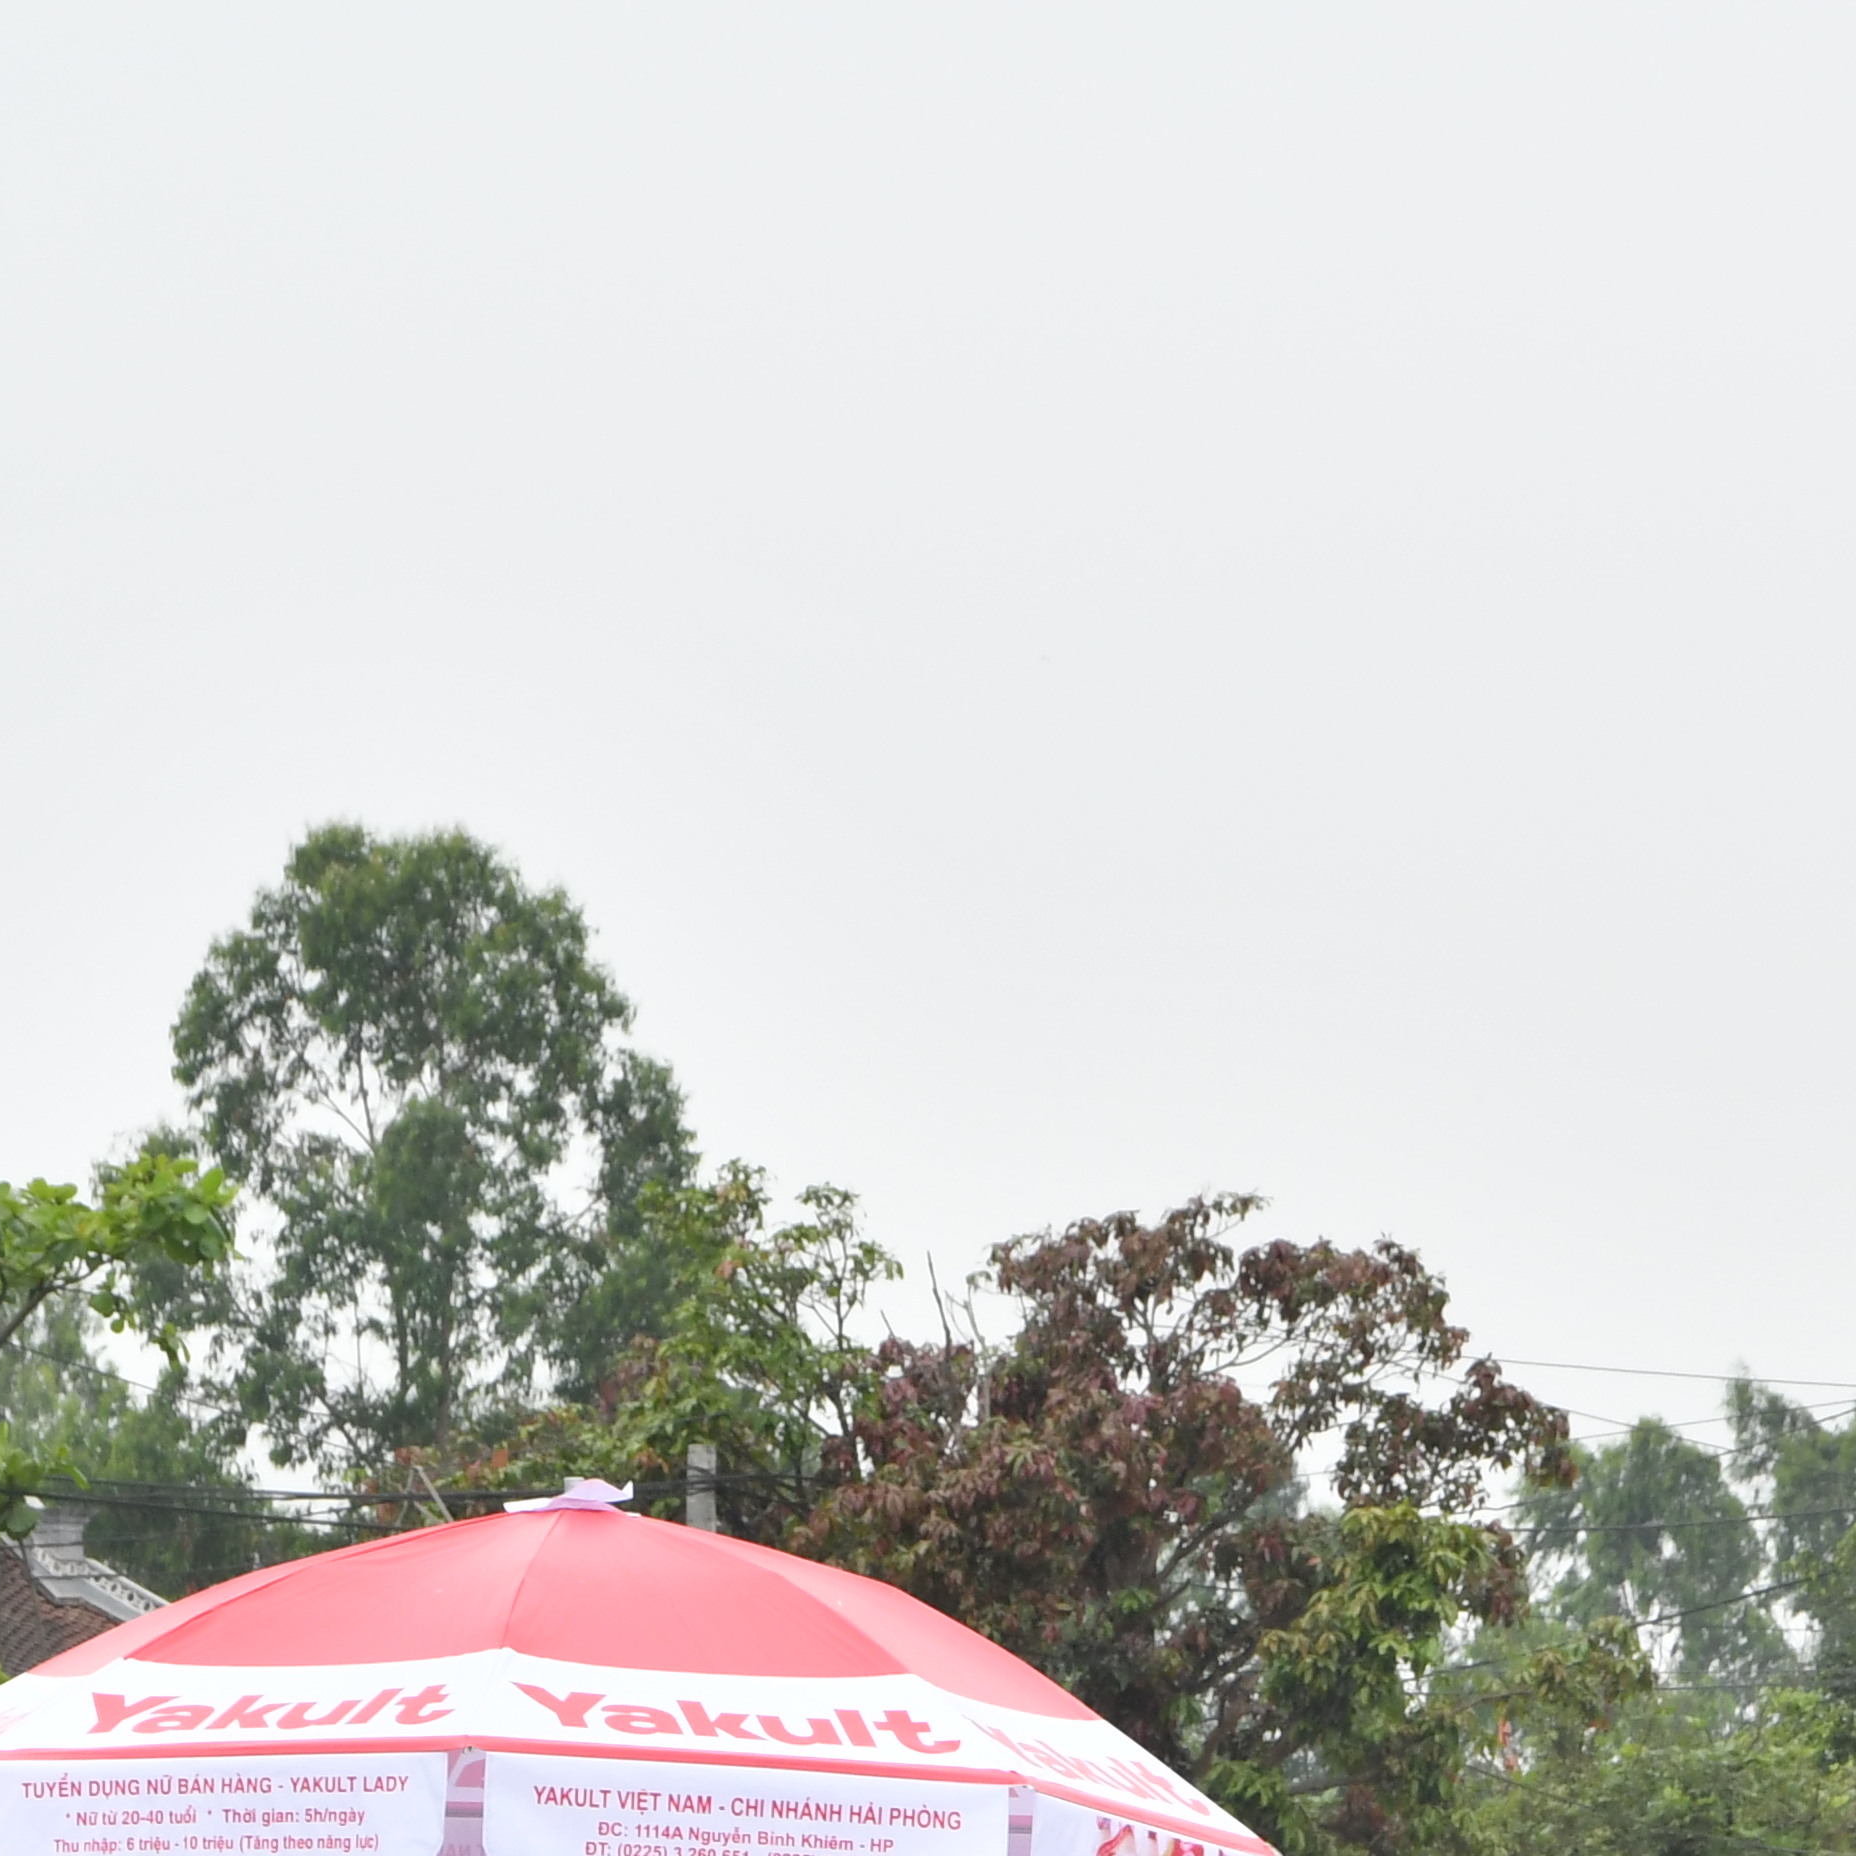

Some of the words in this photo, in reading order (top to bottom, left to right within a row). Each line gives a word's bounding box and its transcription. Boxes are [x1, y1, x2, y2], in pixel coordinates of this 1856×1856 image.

[87, 1683, 456, 1734] Yakult
[509, 1681, 962, 1754] Yakult
[961, 1714, 1211, 1816] Yakult
[22, 1772, 82, 1799] TUYỂN
[89, 1779, 140, 1800] DỤNG
[147, 1774, 173, 1795] NỮ
[178, 1773, 215, 1795] BÁN
[221, 1773, 272, 1793] HÀNG
[290, 1776, 357, 1793] YAKULT
[363, 1776, 409, 1793] LADY
[76, 1811, 98, 1826] Nữ
[102, 1810, 117, 1825] từ
[121, 1810, 164, 1825] 20-40
[169, 1805, 196, 1824] tuổi
[223, 1808, 257, 1824] Thời
[261, 1808, 300, 1827] gian:
[304, 1807, 365, 1826] 5h/ngày
[534, 1785, 611, 1808] YAKULT
[617, 1789, 662, 1815] VIỆT
[668, 1794, 712, 1815] NAM
[731, 1797, 765, 1818] CHI
[771, 1797, 843, 1822] NHÁNH
[849, 1802, 883, 1825] HẢI
[889, 1804, 962, 1830] PHÒNG
[54, 1839, 79, 1852] Thu
[83, 1838, 122, 1854] nhập:
[126, 1837, 135, 1850] 6
[139, 1837, 170, 1853] triệu
[183, 1836, 198, 1850] 10
[202, 1836, 234, 1853] triệu
[283, 1835, 313, 1849] theo
[355, 1833, 379, 1851] lực)
[585, 1841, 611, 1856] ĐT:
[598, 1821, 629, 1837] ĐC:
[634, 1824, 684, 1841] 1114A
[688, 1826, 751, 1847] Nguyễn
[801, 1834, 854, 1851] Khiêm
[870, 1838, 894, 1853] HP
